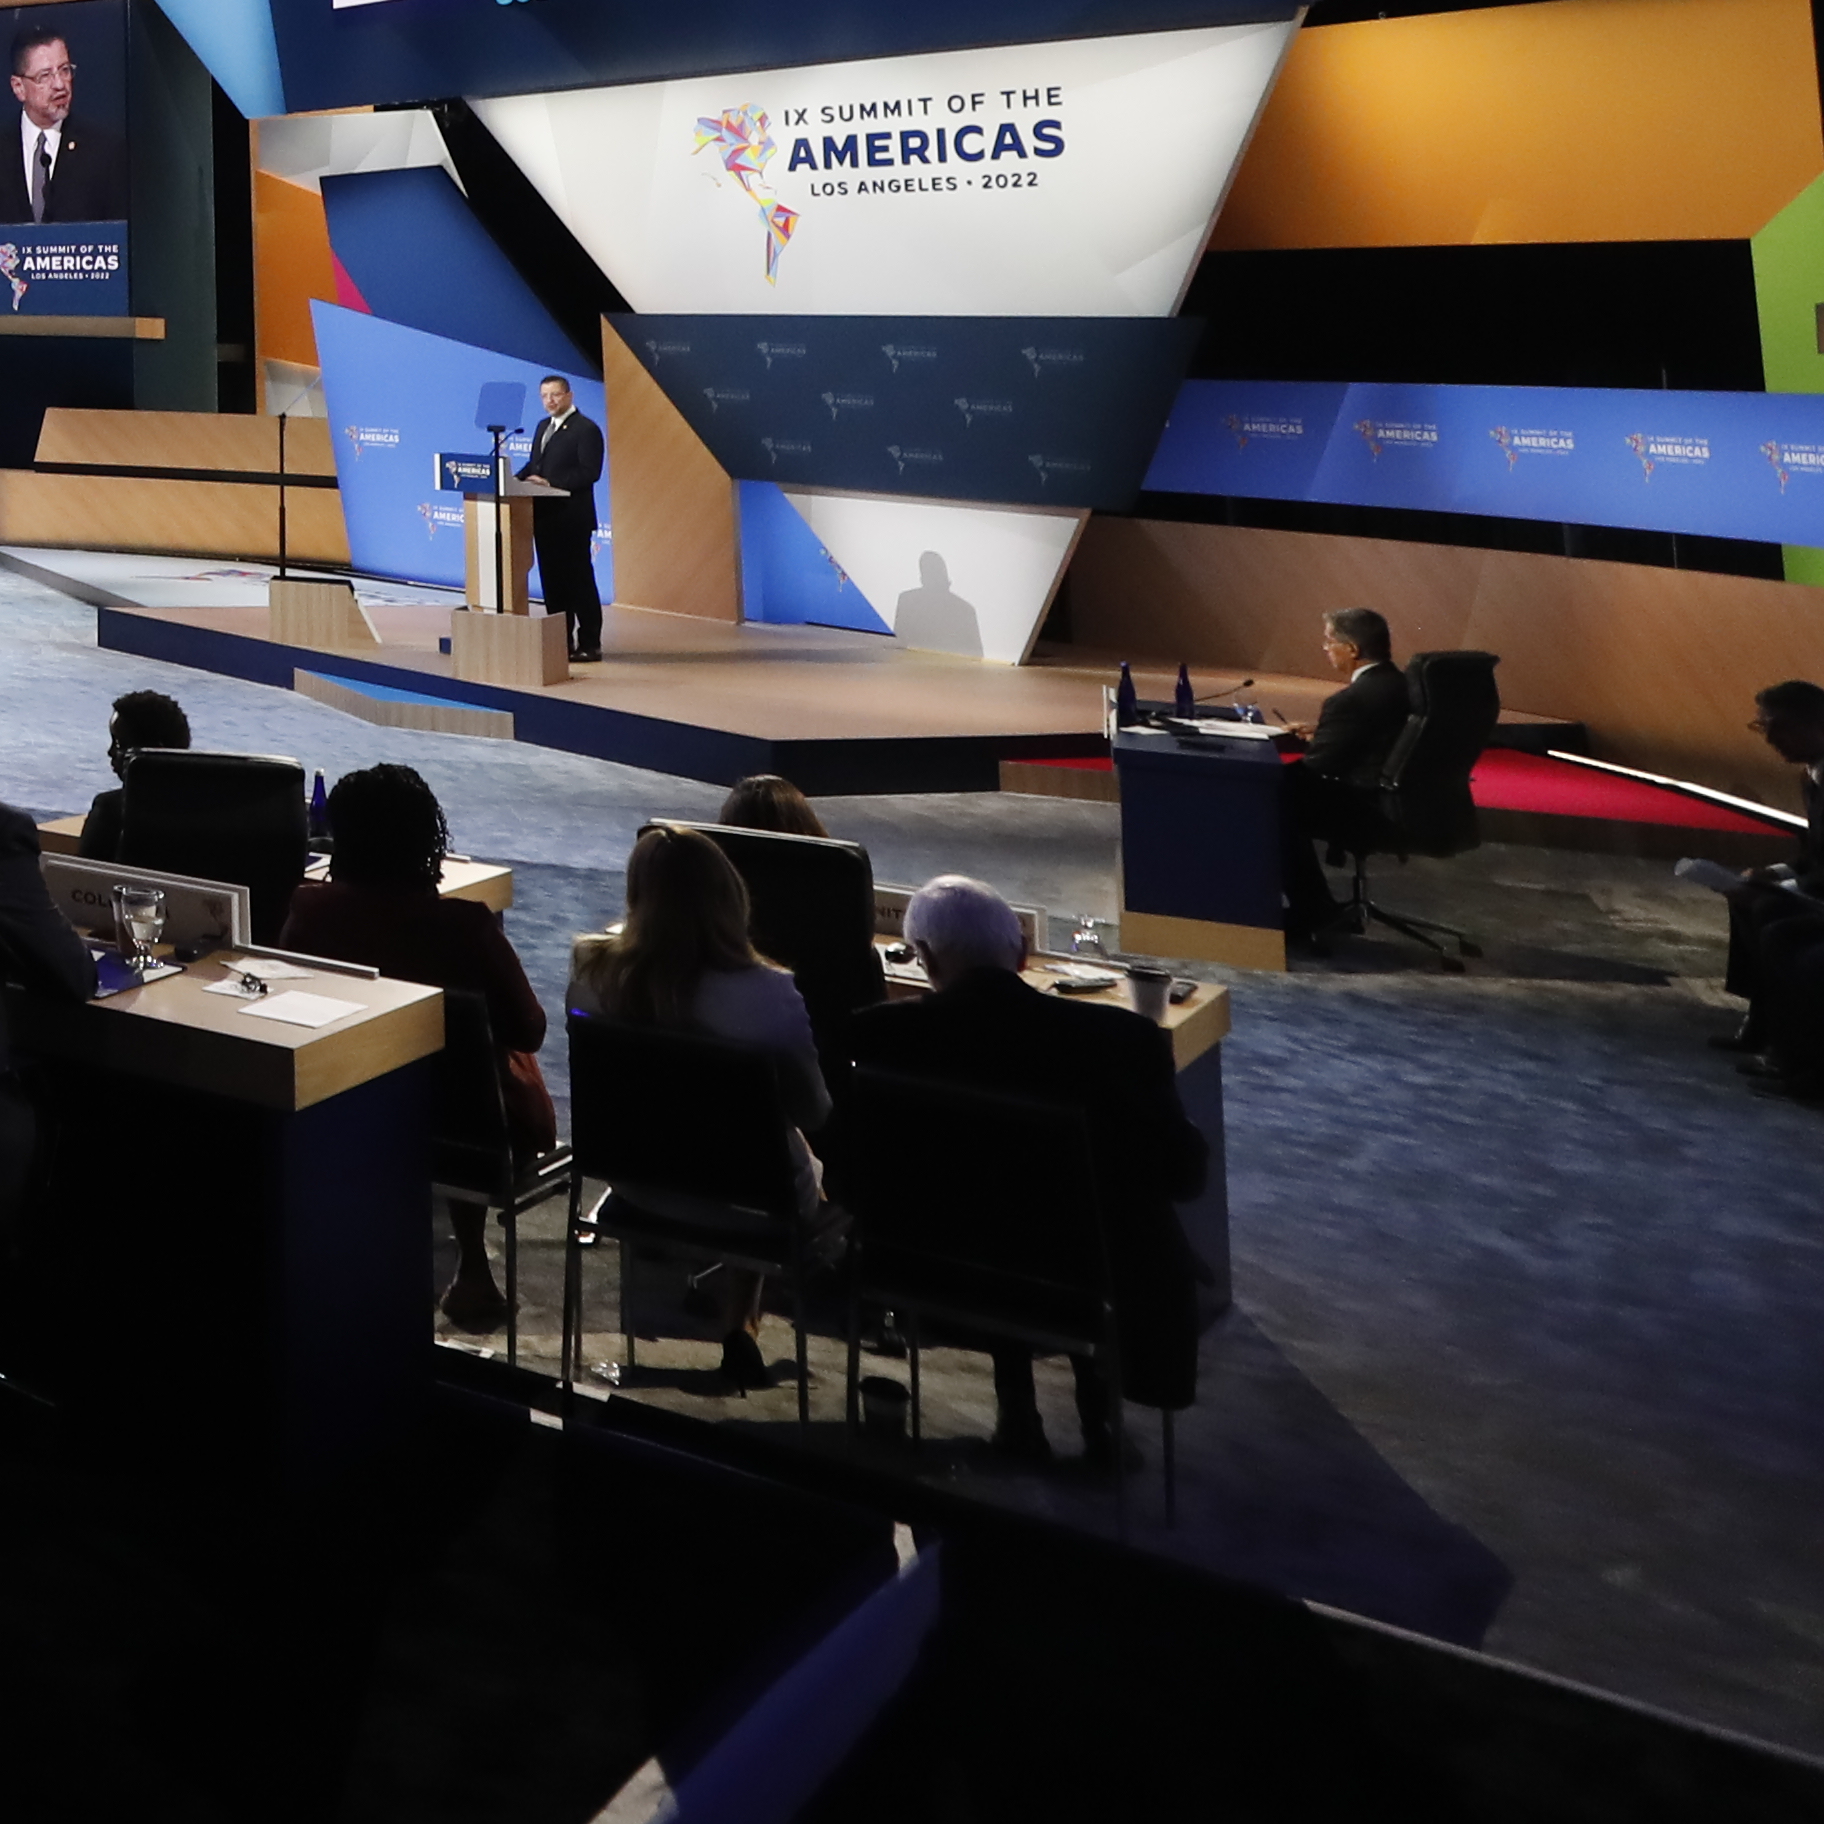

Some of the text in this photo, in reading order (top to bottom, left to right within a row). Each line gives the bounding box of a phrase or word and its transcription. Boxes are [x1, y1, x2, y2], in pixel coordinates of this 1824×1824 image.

[784, 86, 1064, 126] IX SUMMIT OF THE
[788, 119, 1066, 172] AMERICAS
[811, 172, 1039, 197] LOS ANGELES 2022
[21, 244, 120, 255] IX SUMMIT OF THE
[23, 255, 120, 272] AMERICAS
[1243, 423, 1304, 435] AMERICAS
[1377, 429, 1438, 442] AMERICAS
[360, 433, 400, 444] AMERICAS
[1513, 436, 1575, 450] AMERICAS
[1649, 444, 1711, 460] AMERICAS
[1783, 452, 1824, 467] AMERIC
[433, 511, 464, 523] AMERIC
